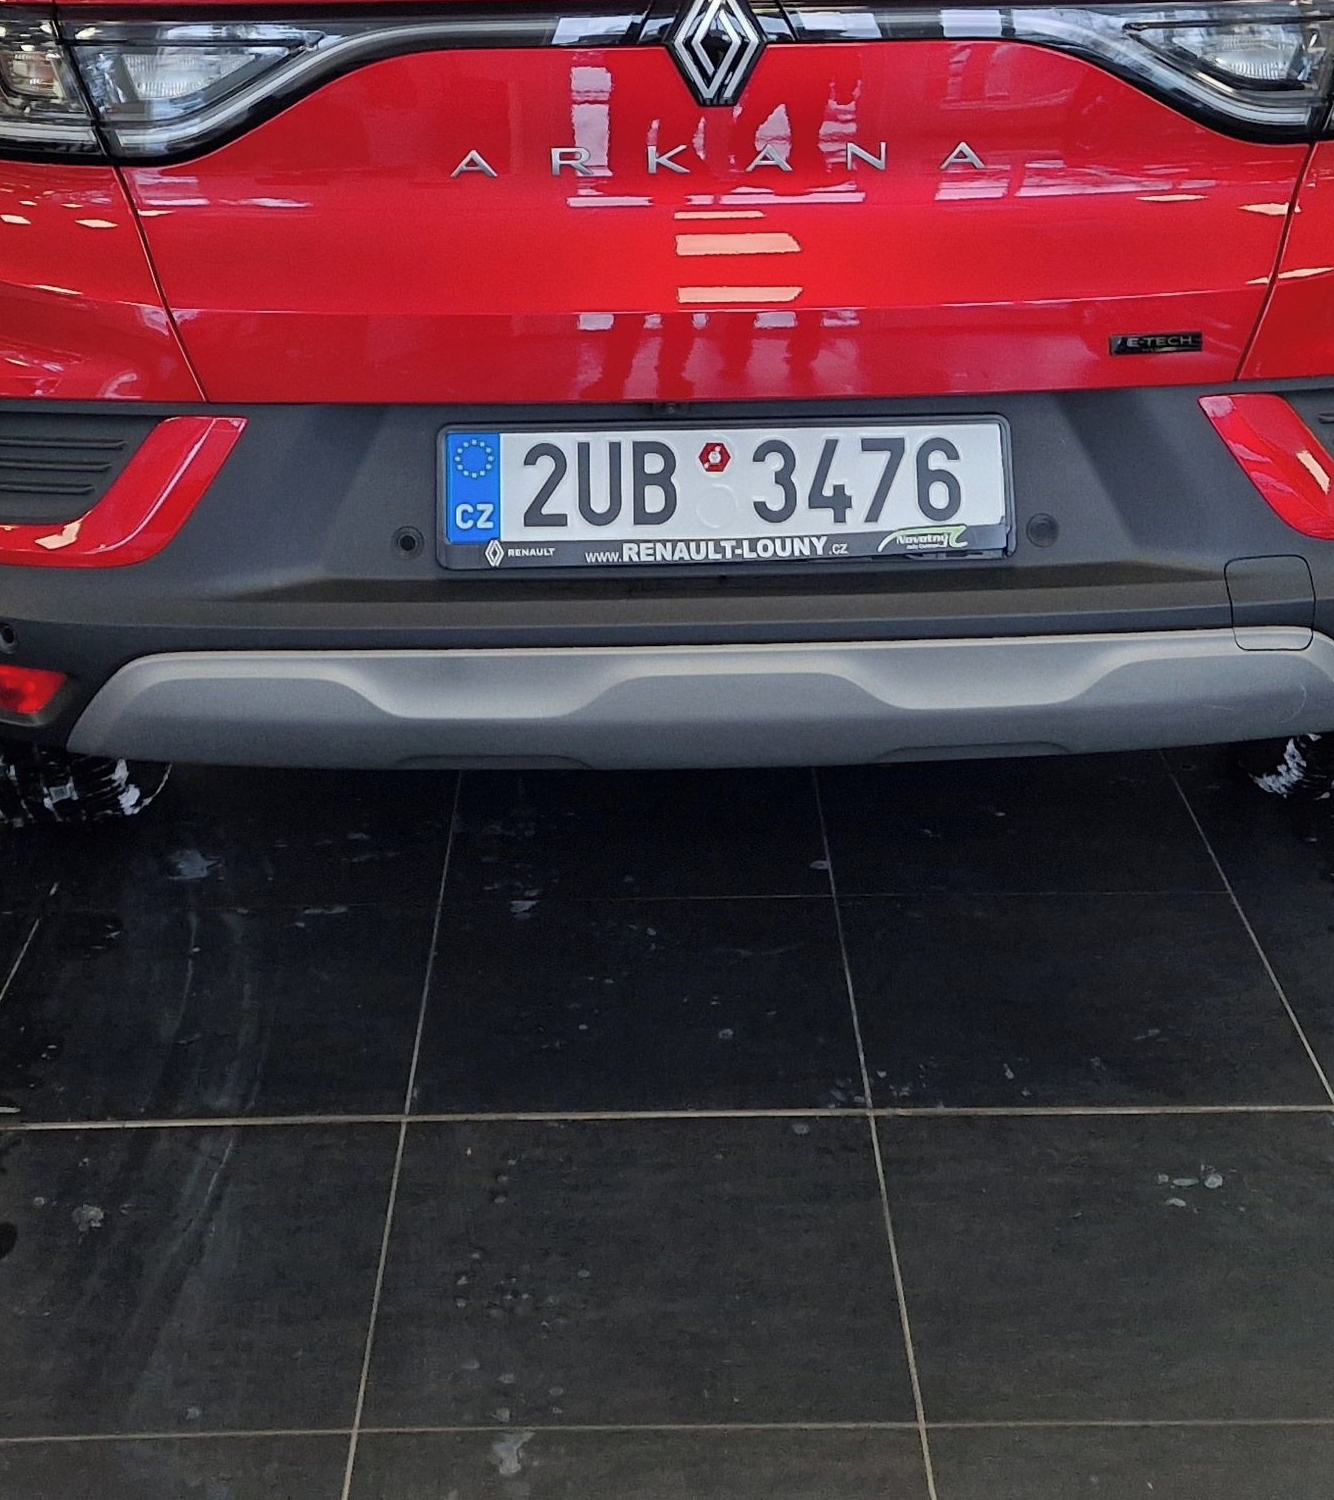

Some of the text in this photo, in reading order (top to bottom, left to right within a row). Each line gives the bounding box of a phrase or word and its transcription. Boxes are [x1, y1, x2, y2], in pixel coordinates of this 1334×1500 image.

[450, 141, 986, 177] ARKANA
[1126, 336, 1192, 348] E-TECH
[523, 437, 962, 527] 2UB 3476
[455, 503, 495, 530] CZ
[507, 547, 555, 557] RENAULT
